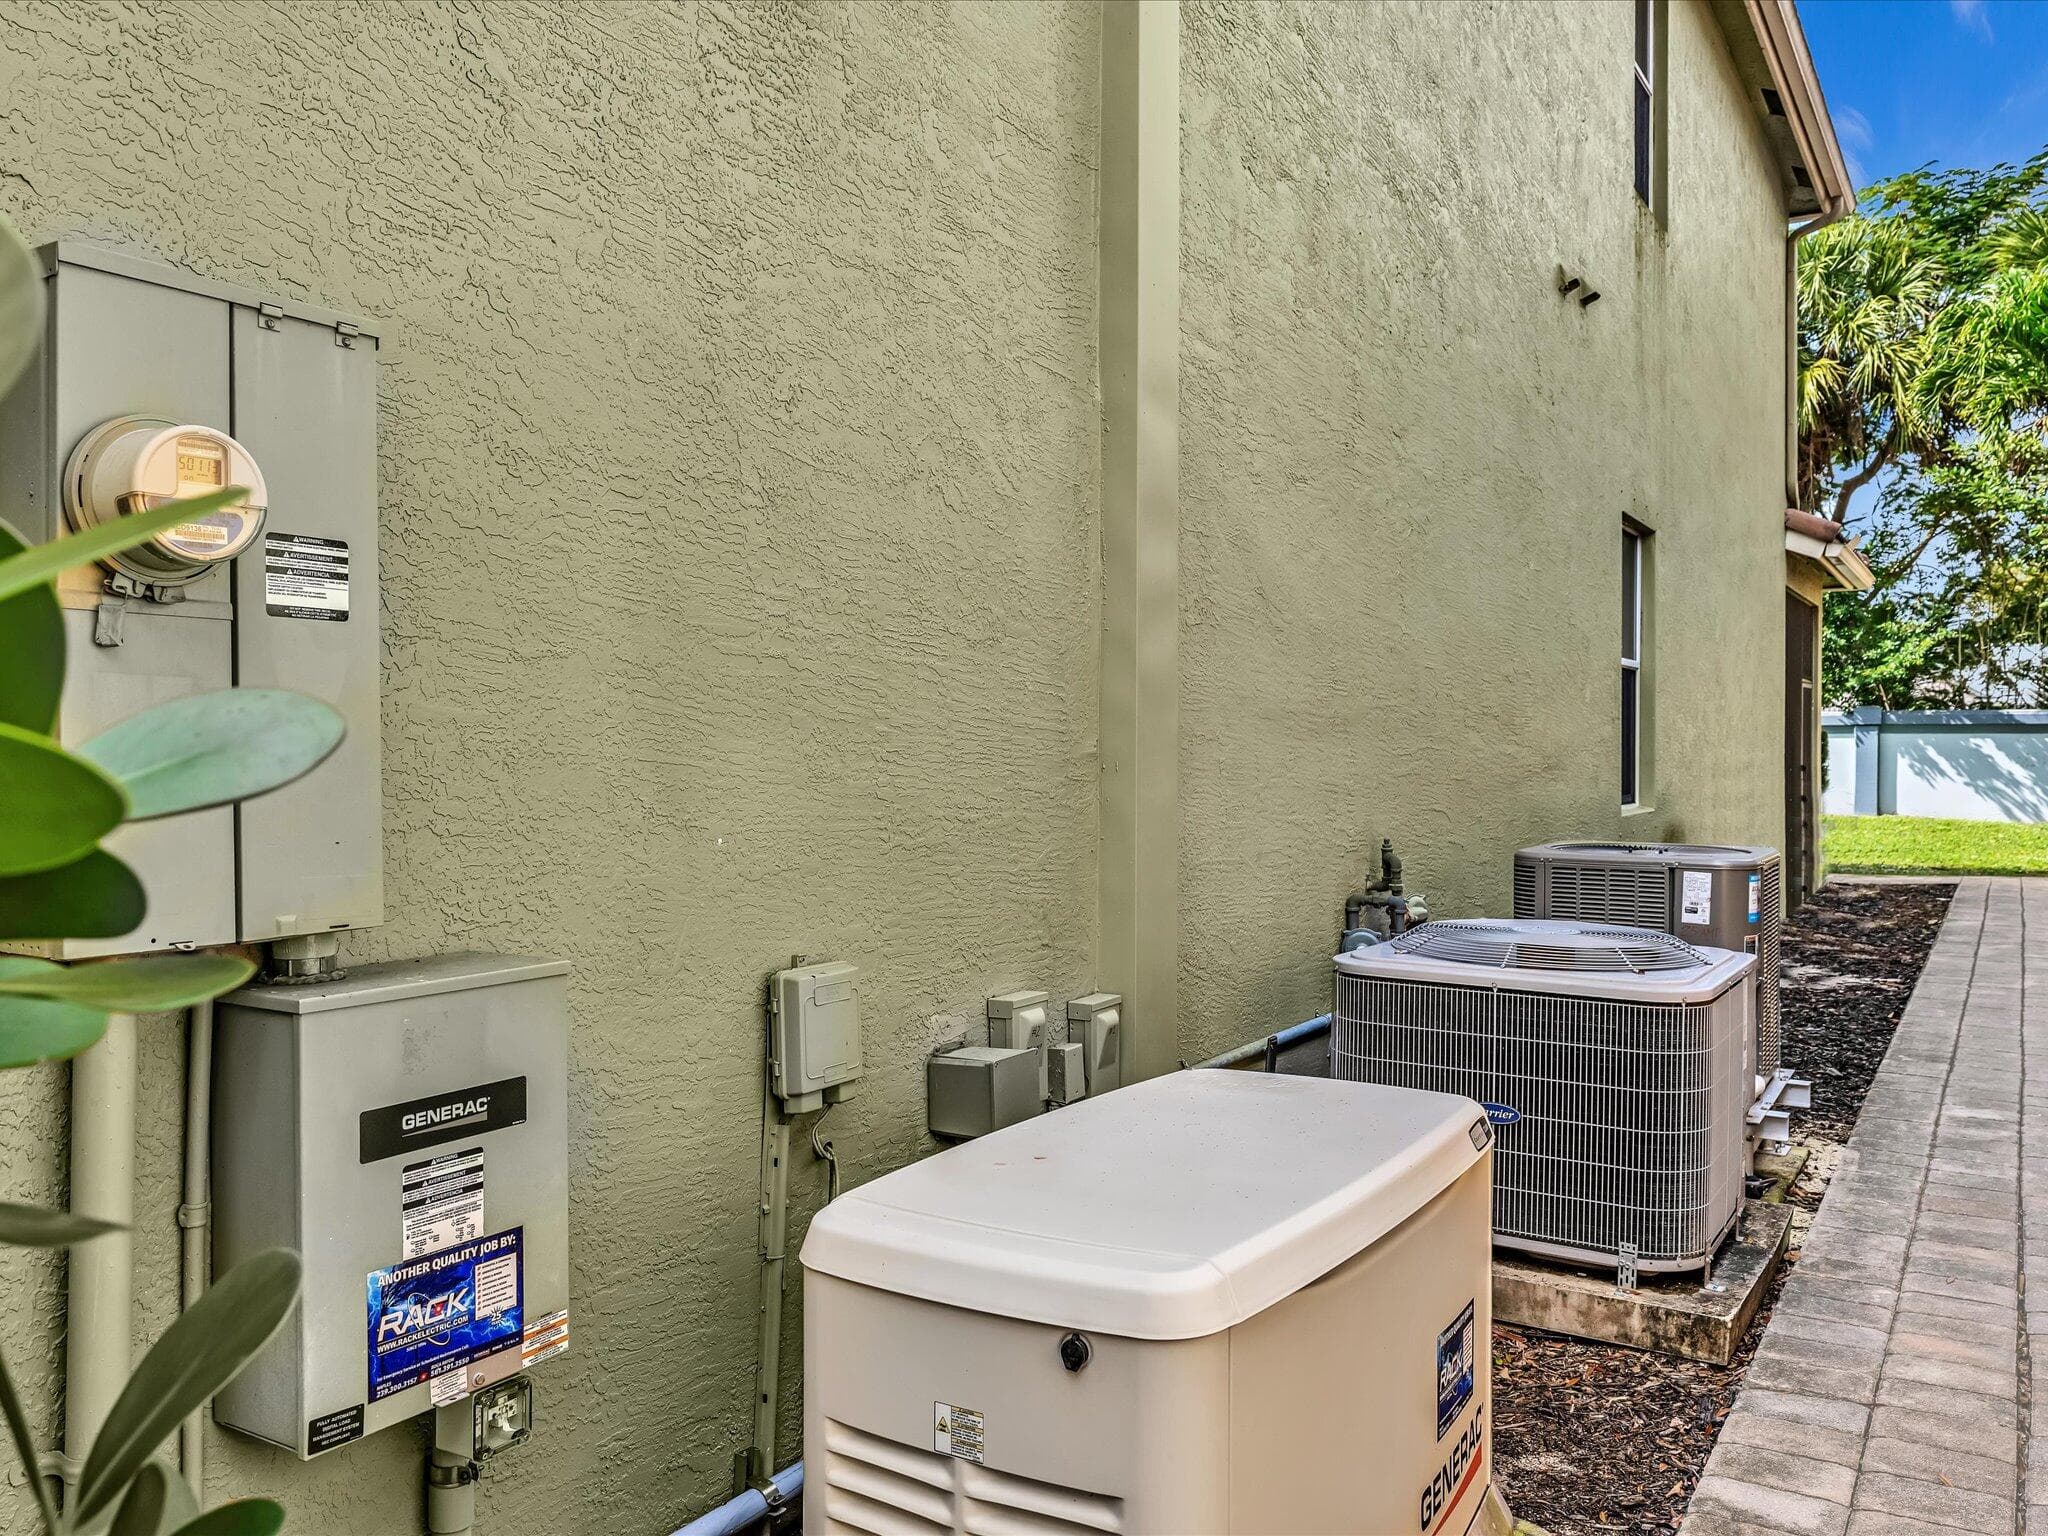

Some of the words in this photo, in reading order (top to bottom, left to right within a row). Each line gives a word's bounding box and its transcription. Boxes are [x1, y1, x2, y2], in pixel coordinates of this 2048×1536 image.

[299, 537, 324, 545] WARNING
[293, 570, 330, 578] ADVERTENCIA
[402, 1097, 488, 1130] GENERAC
[378, 1263, 430, 1287] ANOTHER
[432, 1247, 479, 1270] QUALITY
[479, 1241, 498, 1259] JOB
[499, 1235, 516, 1249] BY:
[377, 1287, 469, 1342] RACK
[377, 1315, 469, 1354] WWW.RACKELECTRIC.COM
[1420, 1412, 1483, 1532] GENERAC
